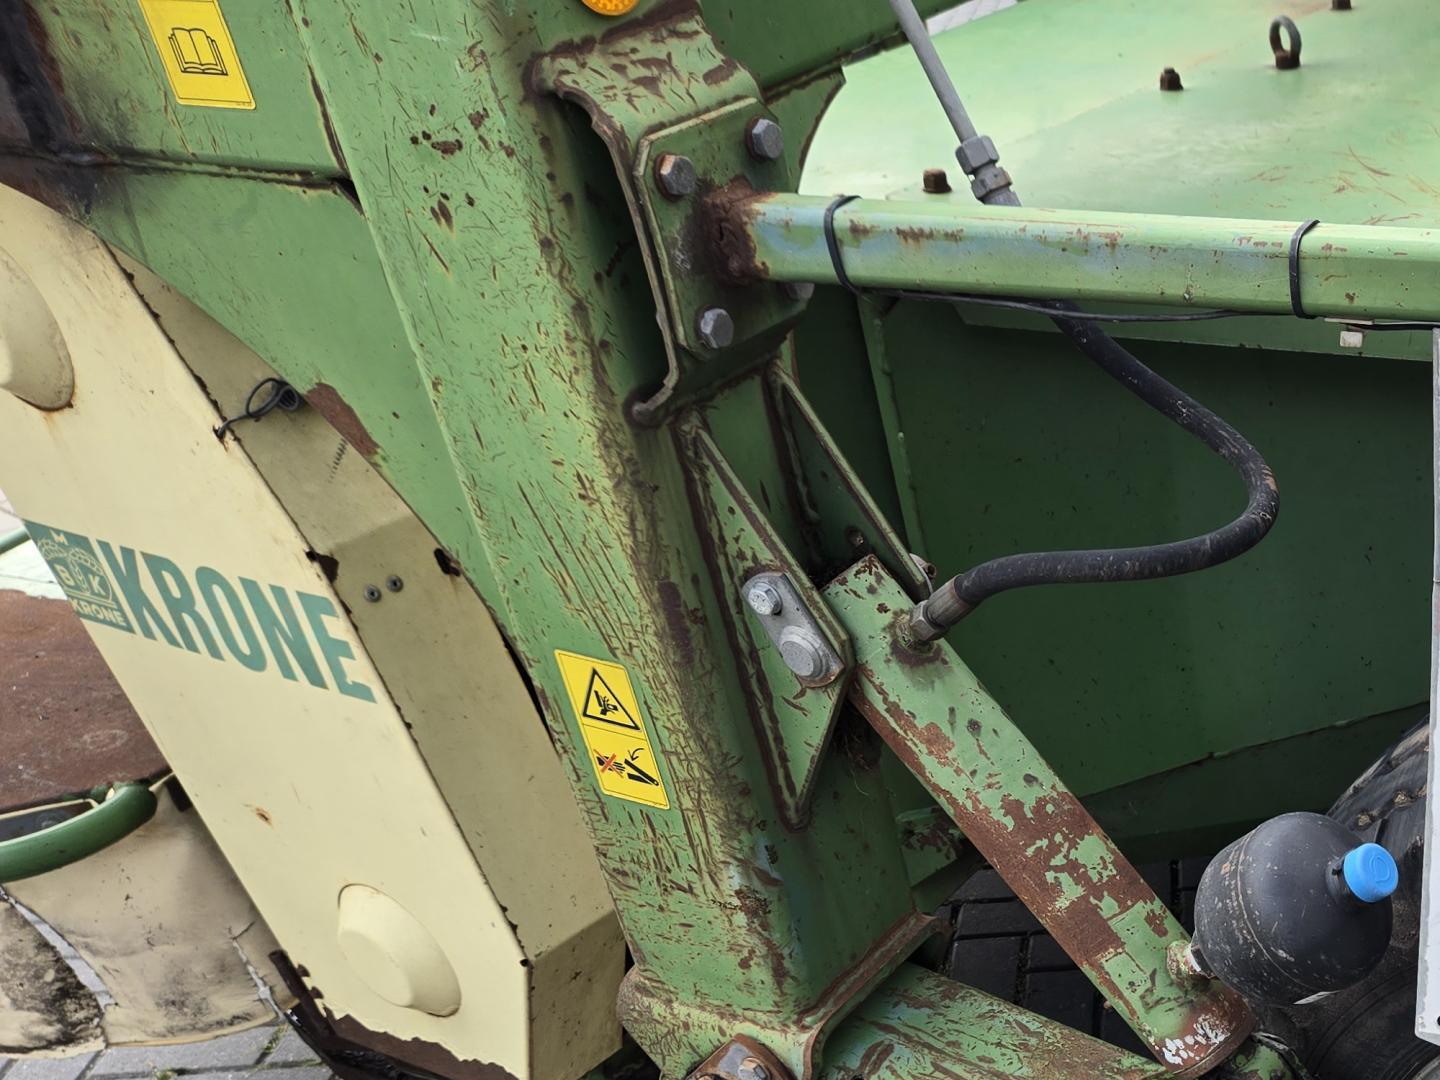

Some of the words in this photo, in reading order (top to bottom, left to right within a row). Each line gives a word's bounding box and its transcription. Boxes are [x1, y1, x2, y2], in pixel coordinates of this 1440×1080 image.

[87, 573, 107, 597] K
[69, 597, 128, 627] KRONE
[95, 538, 378, 704] KRONE
